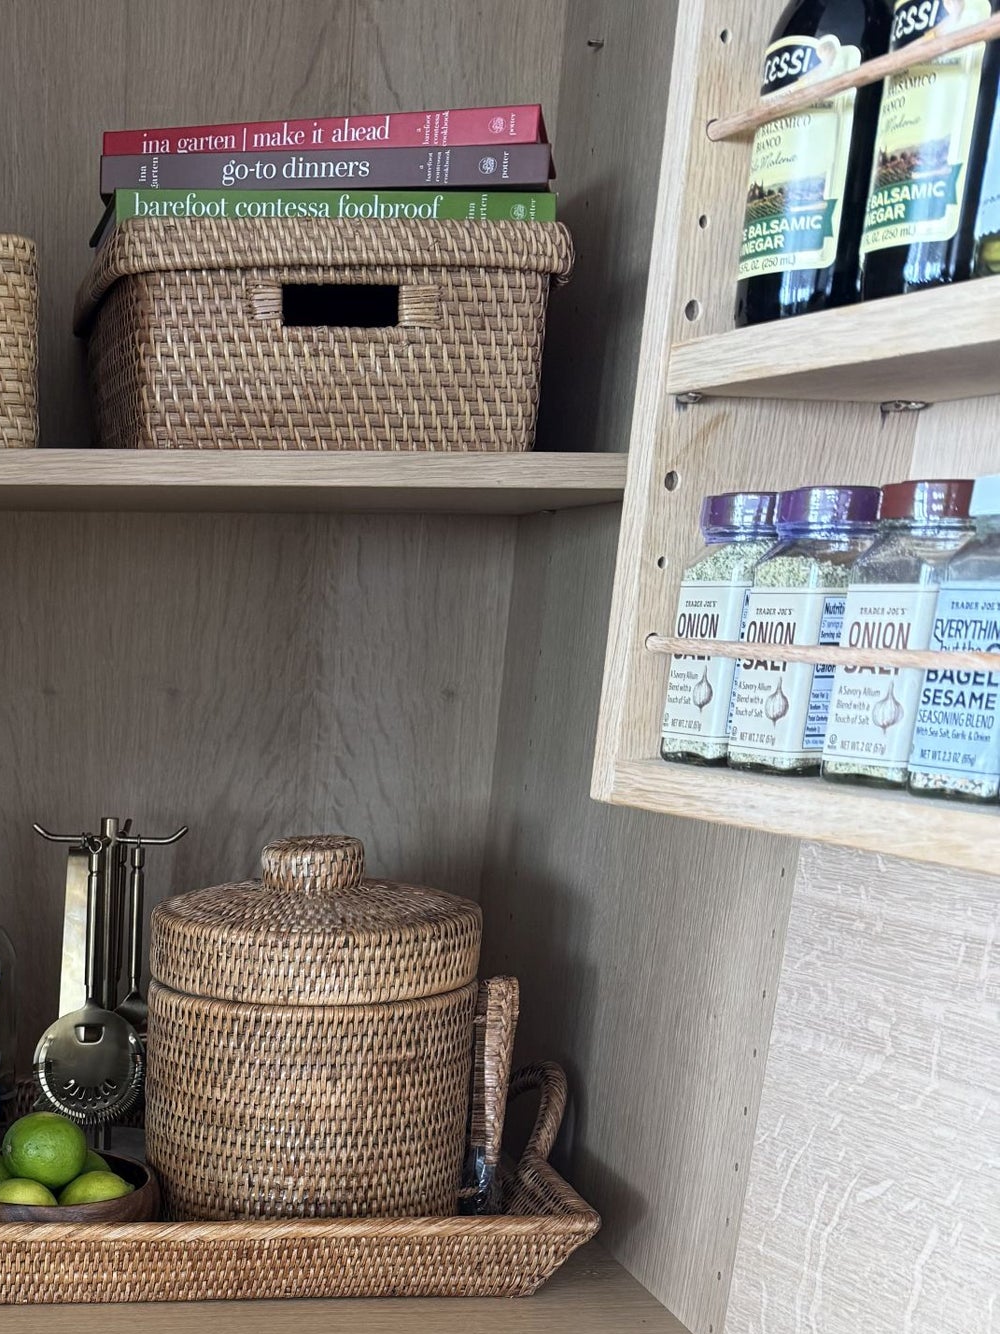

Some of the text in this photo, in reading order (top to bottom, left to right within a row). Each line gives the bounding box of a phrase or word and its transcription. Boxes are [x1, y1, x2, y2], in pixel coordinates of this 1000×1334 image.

[892, 0, 940, 42] ESSI
[765, 48, 812, 84] LESSI
[142, 115, 391, 154] ina garten make it ahead
[221, 156, 370, 187] go-to dinners
[502, 151, 510, 179] potter
[134, 192, 444, 219] barefoot contessa foolproof
[480, 194, 488, 220] arten
[871, 181, 947, 209] BALSAMIC
[747, 215, 824, 239] BALSAMIC
[865, 203, 906, 227] NEGAR
[741, 234, 785, 257] NEGAR
[686, 600, 703, 608] TRADER
[825, 601, 846, 615] Nutriti
[860, 607, 885, 615] TRADER
[951, 601, 979, 610] TRADER
[677, 612, 719, 639] ONION
[747, 620, 796, 645] ONION
[848, 621, 911, 650] ONION
[935, 618, 1000, 641] EVERYTHIN
[816, 663, 836, 673] Calor
[925, 668, 999, 687] BAGEL
[921, 688, 997, 711] SESAME
[918, 709, 995, 730] SEASONING BLEND
[952, 729, 967, 740] Garlic
[974, 732, 991, 742] Onion
[920, 748, 931, 759] NET
